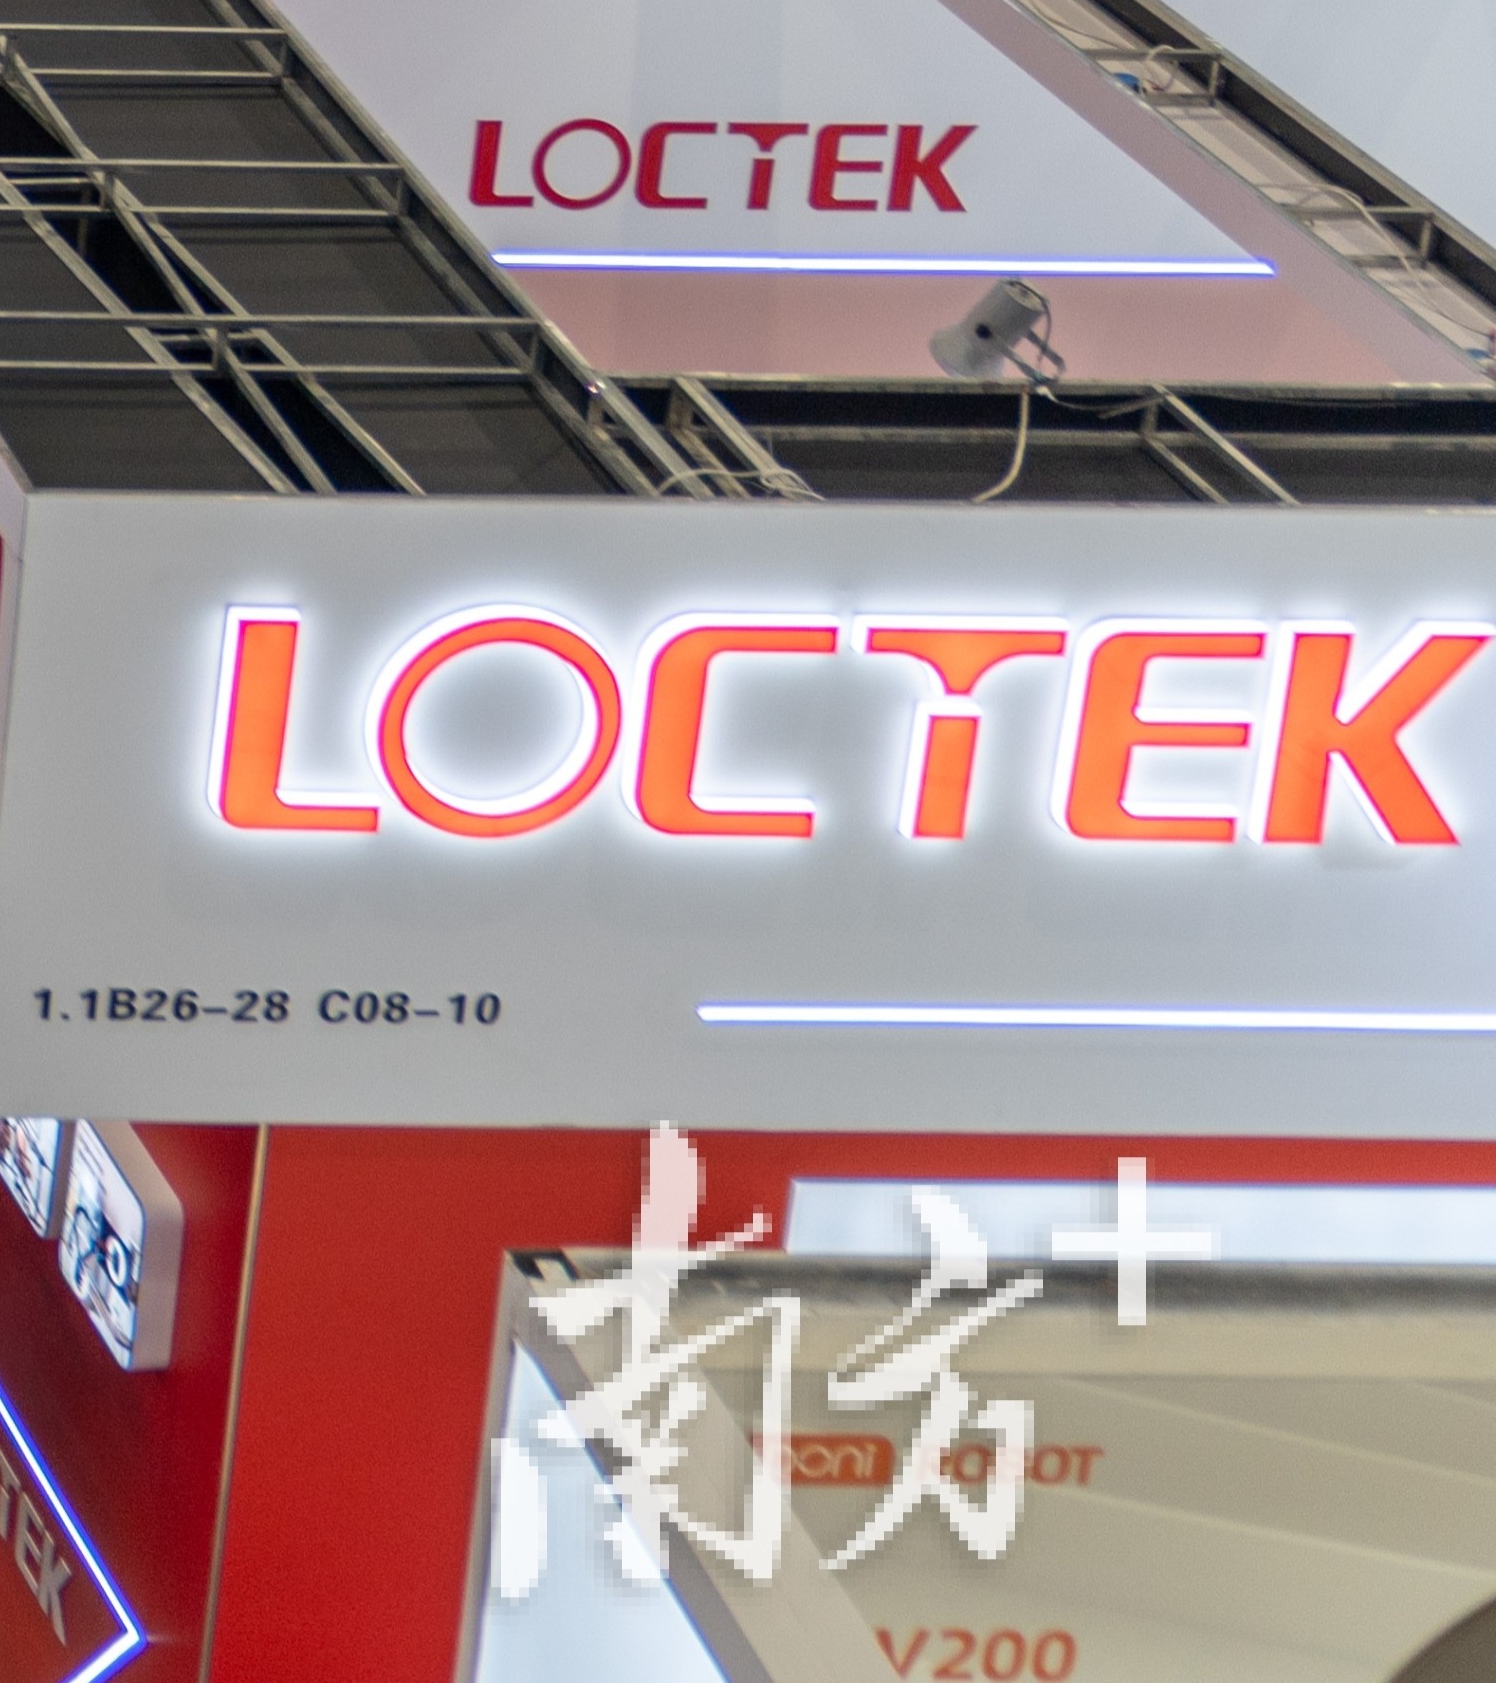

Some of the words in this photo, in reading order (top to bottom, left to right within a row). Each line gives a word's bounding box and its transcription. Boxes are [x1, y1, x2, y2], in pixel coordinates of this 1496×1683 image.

[467, 117, 979, 215] LOCTEK
[208, 603, 1496, 846] LOCTEK
[32, 988, 292, 1024] 1.1B26-28
[317, 989, 504, 1026] C08-10
[874, 1627, 1078, 1683] V200
